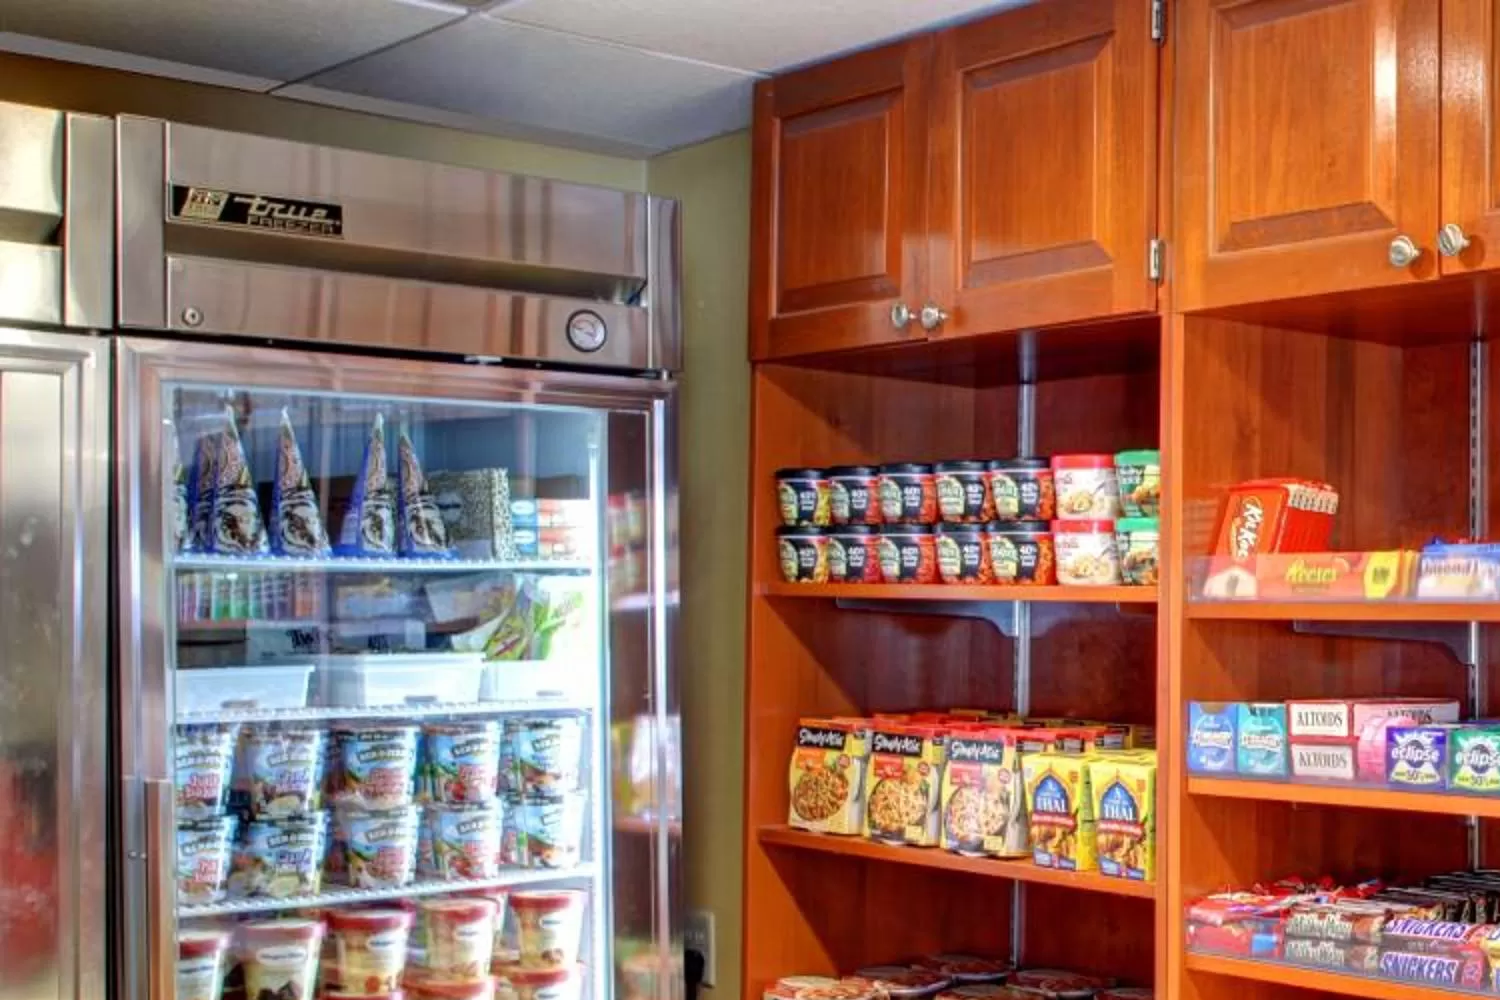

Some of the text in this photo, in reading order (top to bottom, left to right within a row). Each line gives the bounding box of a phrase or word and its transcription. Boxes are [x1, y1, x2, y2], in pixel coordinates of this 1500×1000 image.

[1297, 710, 1343, 727] ALTOIDS
[1299, 750, 1348, 769] ALTOIDS
[1391, 746, 1440, 764] eclipse
[1103, 802, 1134, 821] THAI
[1387, 918, 1468, 940] SNICKERS
[1381, 952, 1459, 982] SNICKERS
